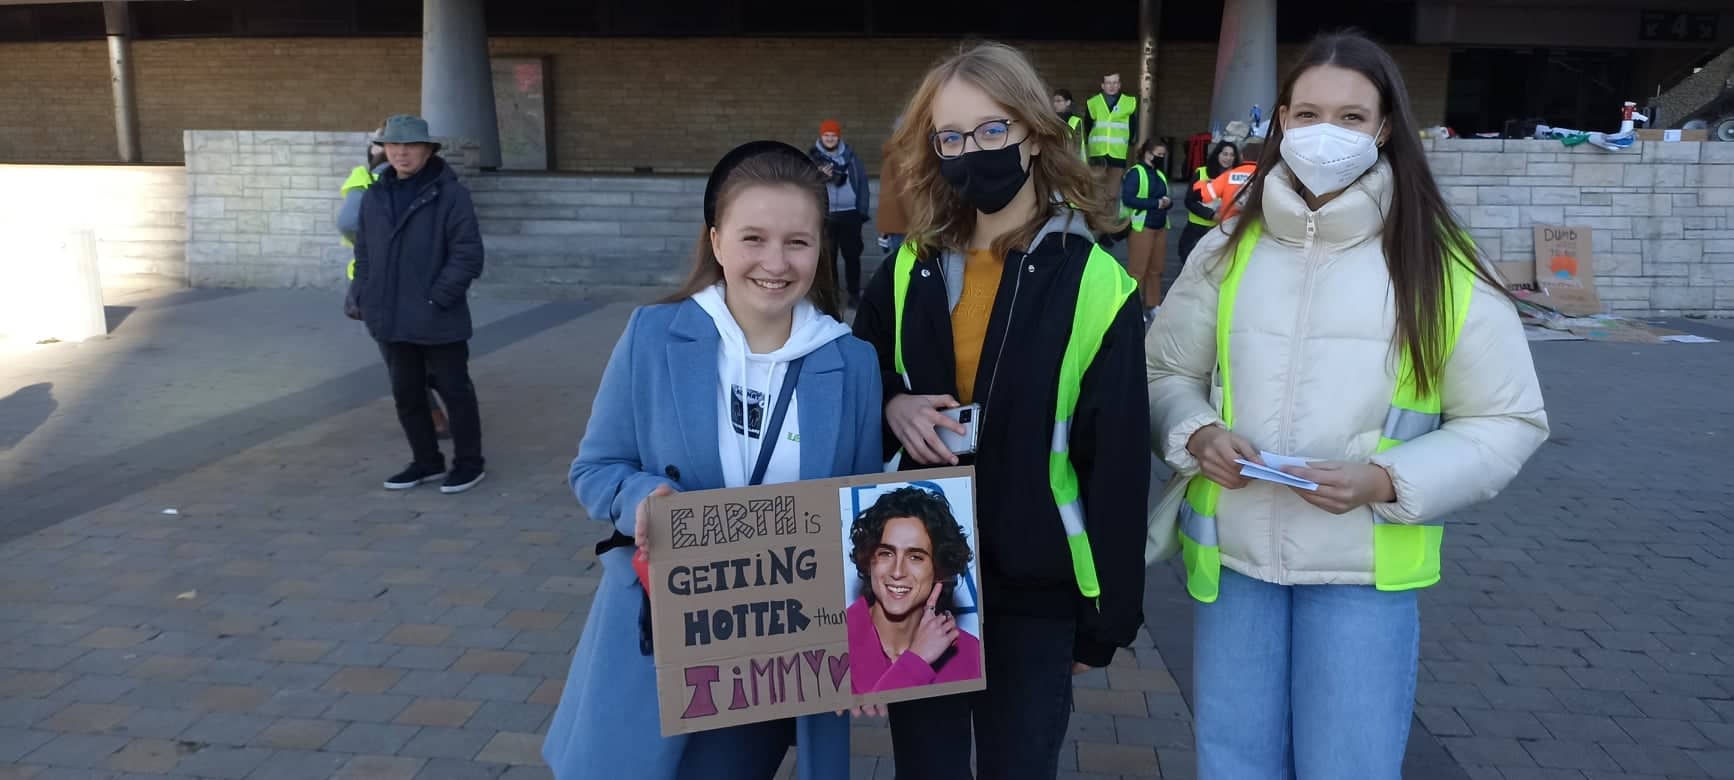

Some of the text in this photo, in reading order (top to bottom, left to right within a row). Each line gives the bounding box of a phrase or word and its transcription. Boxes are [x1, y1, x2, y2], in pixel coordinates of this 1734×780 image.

[671, 496, 822, 549] EARTH is
[684, 599, 848, 647] HOTTER than
